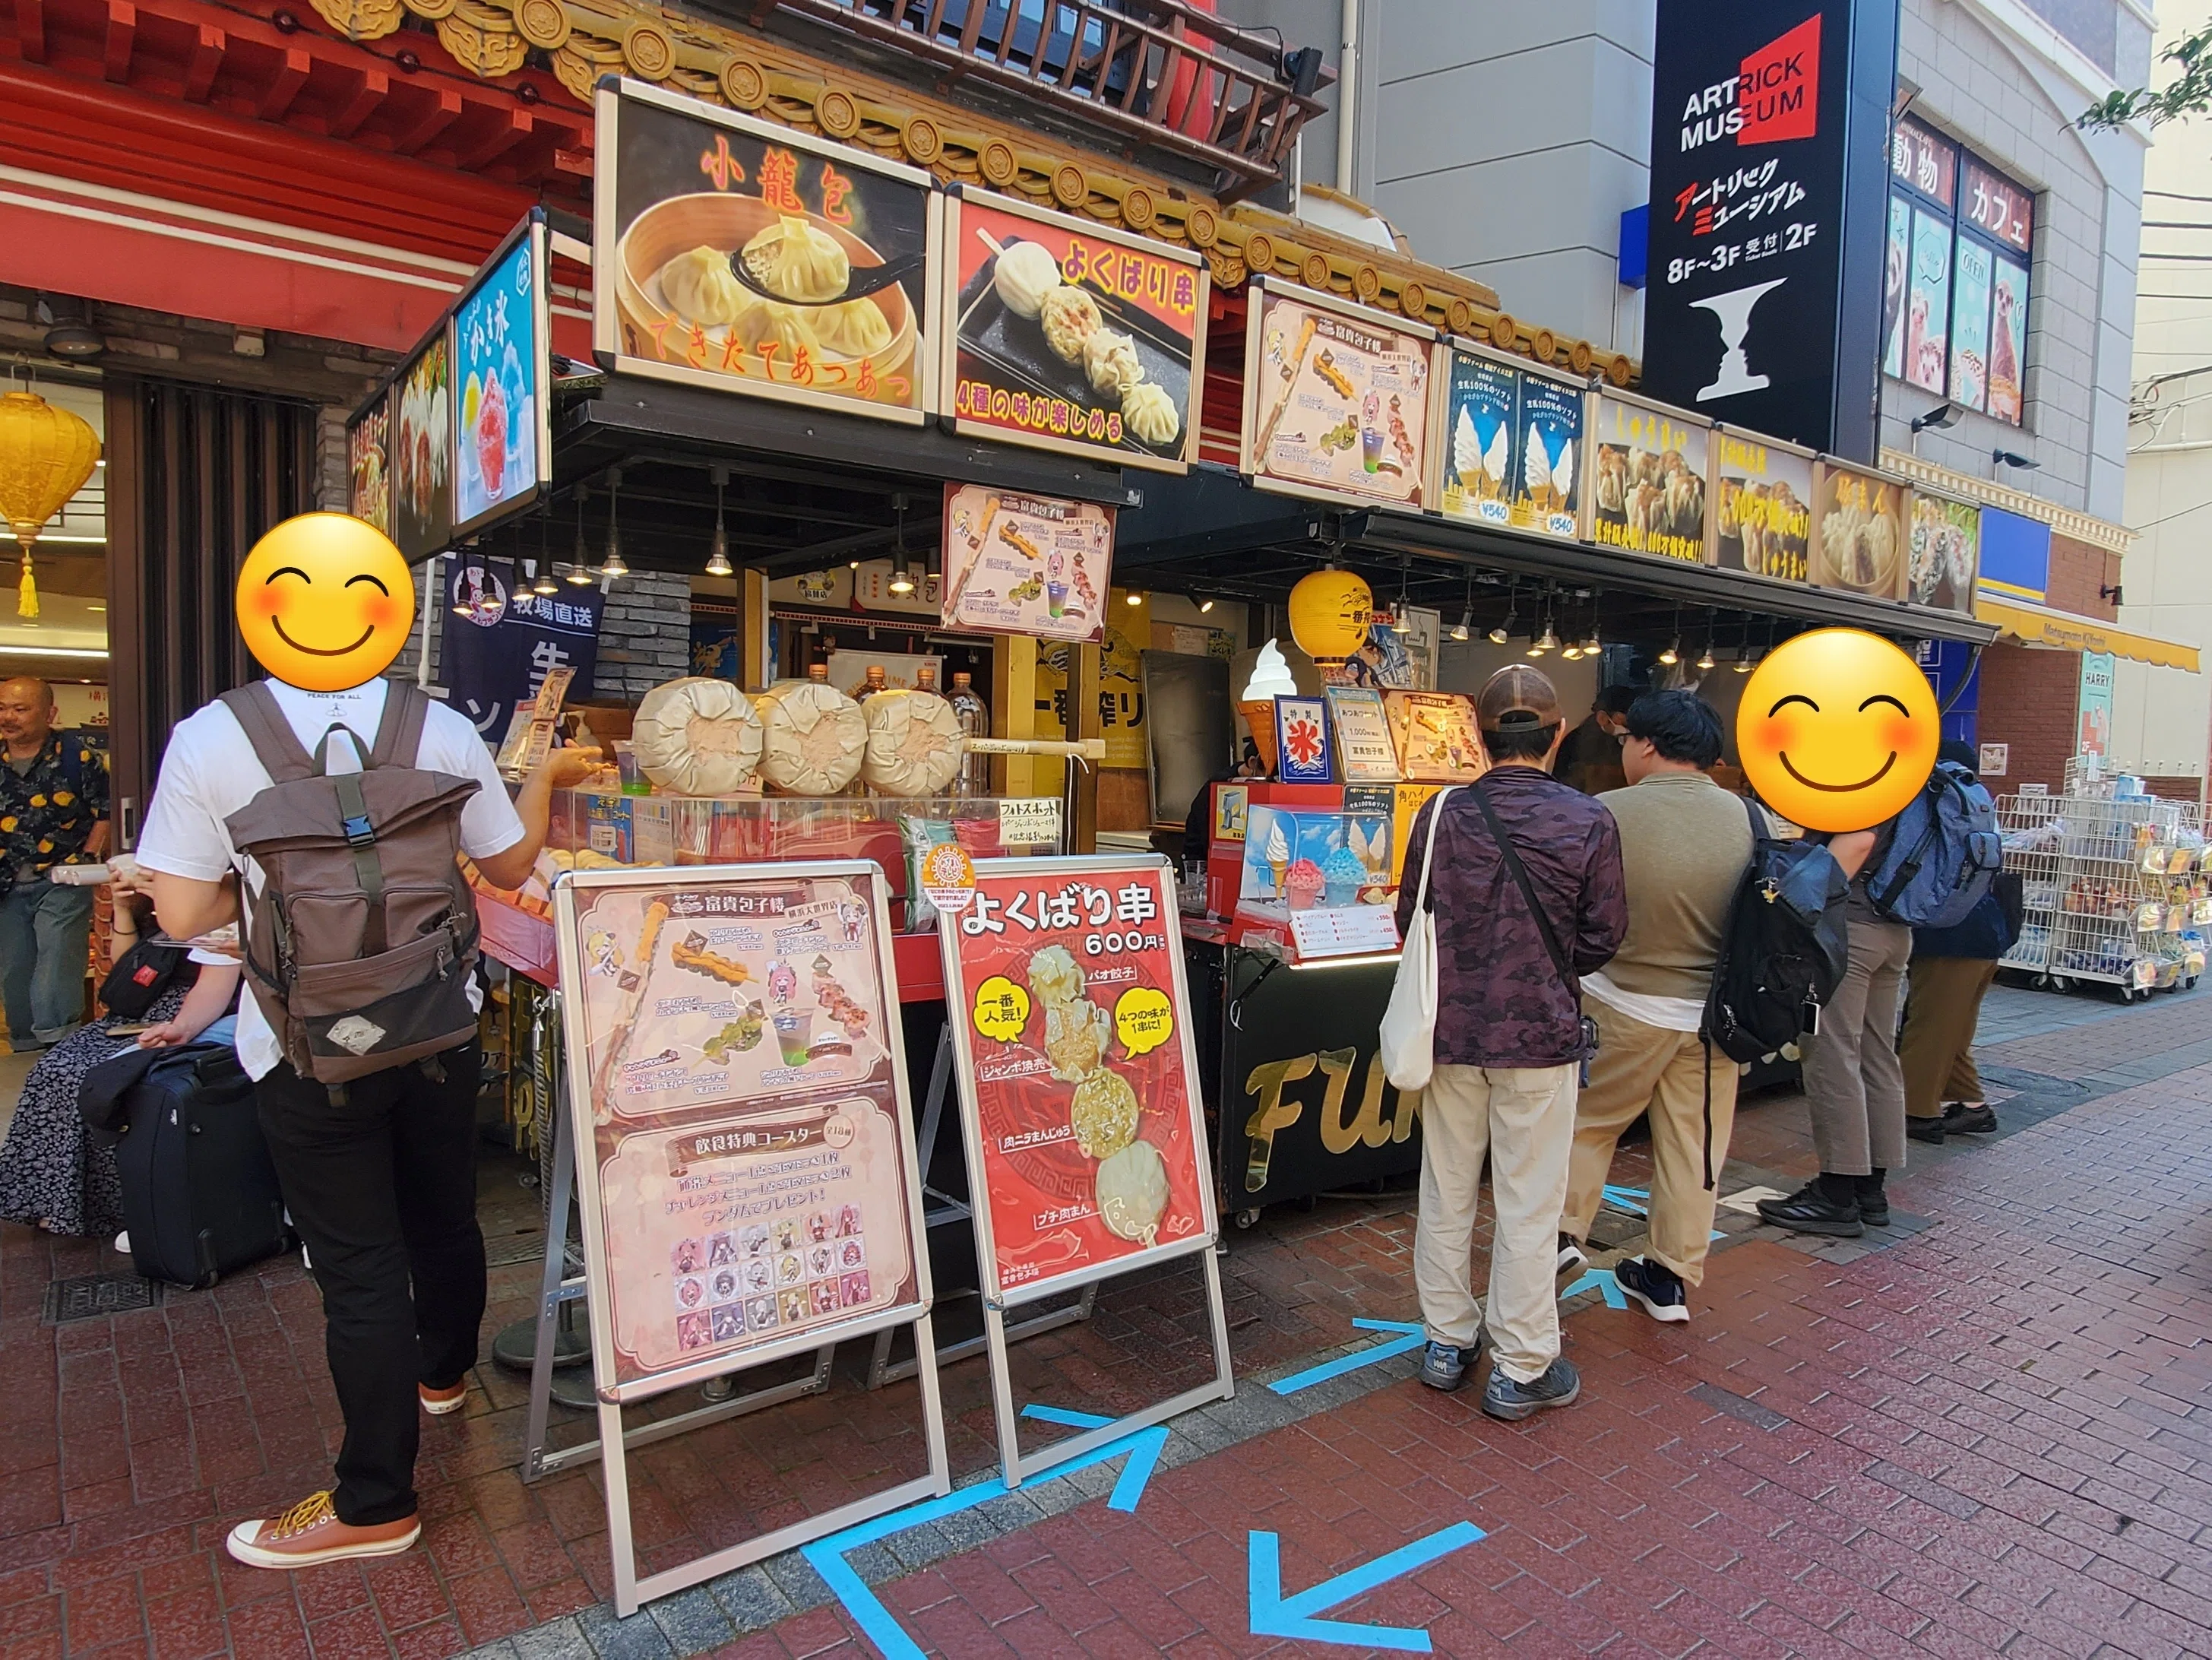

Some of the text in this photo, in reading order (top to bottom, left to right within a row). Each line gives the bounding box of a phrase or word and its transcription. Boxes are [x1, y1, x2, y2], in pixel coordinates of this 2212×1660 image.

[1681, 84, 1803, 153] MUSEUM
[701, 133, 854, 226] 小籠包
[1893, 132, 2024, 244] 動物 カフェ
[1745, 232, 1778, 255] 受付
[1784, 223, 1818, 252] 2F
[1062, 239, 1197, 315] よくばり串
[956, 379, 1125, 443] 4種の味が楽しめる
[1482, 501, 1508, 522] ¥540
[1550, 517, 1574, 534] ¥540
[513, 595, 593, 629] 牧場直送
[2085, 671, 2110, 688] HARRY
[1286, 719, 1320, 765] 氷
[1001, 800, 1055, 816] フォトスポット
[705, 895, 786, 914] 富貴包子楼
[961, 882, 1157, 936] よくばり串
[1084, 930, 1159, 955] 600円
[1088, 967, 1135, 982] パオ餃子
[982, 993, 1015, 1008] 一番
[983, 1002, 1022, 1024] 人気!
[1119, 1005, 1170, 1024] 4つの味が
[1131, 1018, 1162, 1035] 1串に!
[983, 1058, 1047, 1078] ジャンボ焼売
[695, 1126, 823, 1155] 飲食特典コースター
[825, 1124, 852, 1139] 全18種
[1003, 1124, 1071, 1149] 肉ニラまんじゅう
[1036, 1204, 1091, 1227] プチ肉まん
